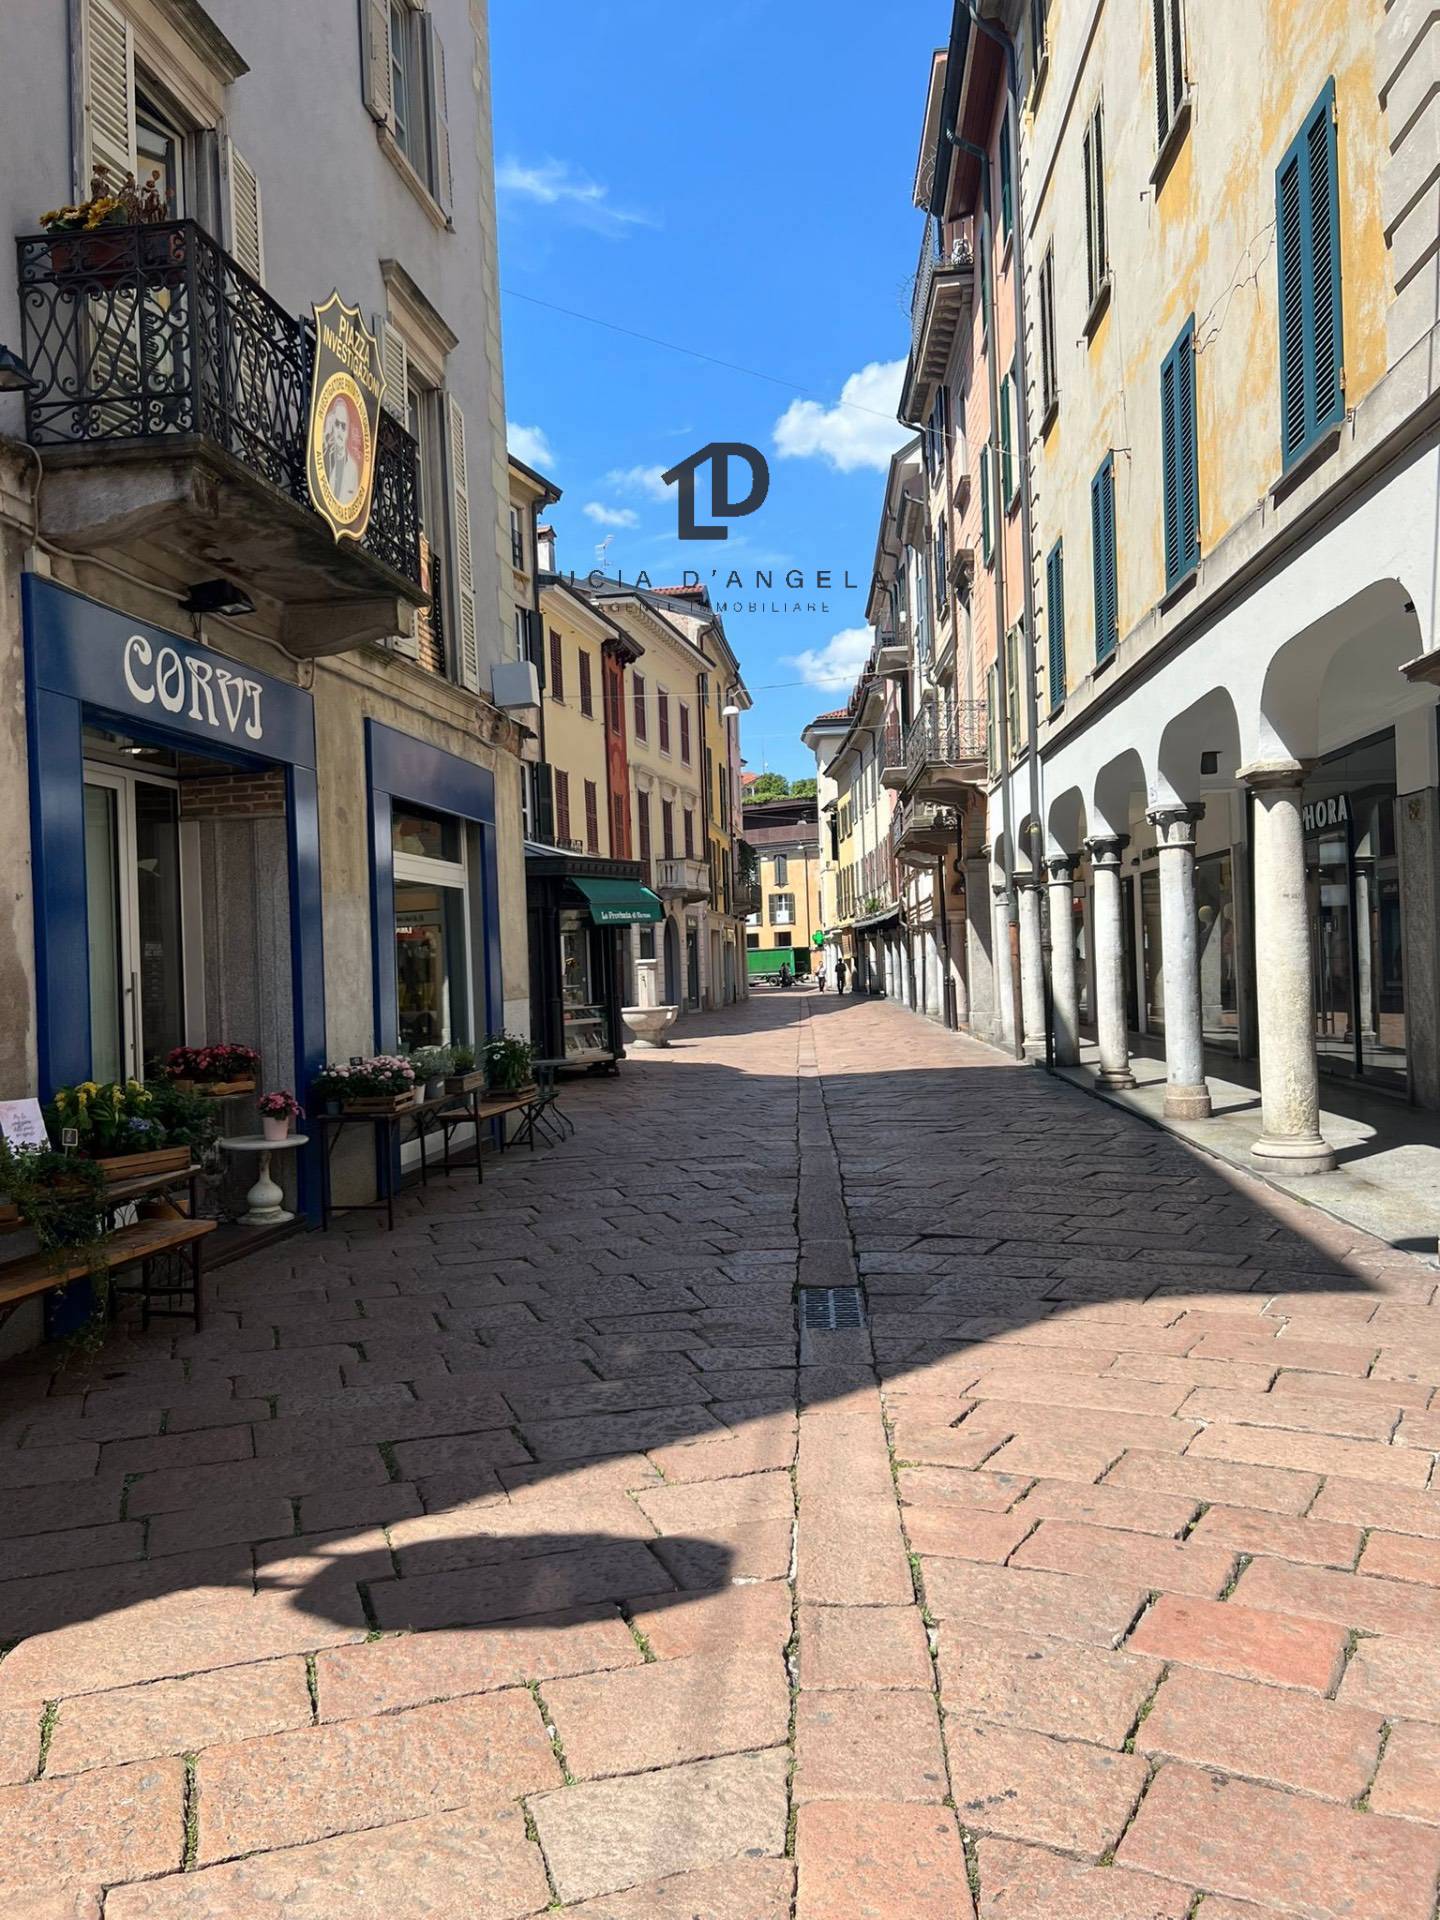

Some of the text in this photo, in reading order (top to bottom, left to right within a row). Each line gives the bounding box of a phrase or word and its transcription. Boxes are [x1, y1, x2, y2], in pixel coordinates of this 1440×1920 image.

[322, 324, 381, 400] INVESTIGAZIONI
[338, 314, 371, 369] PIAZZA
[124, 635, 263, 740] CORVI
[1303, 795, 1348, 830] HORA
